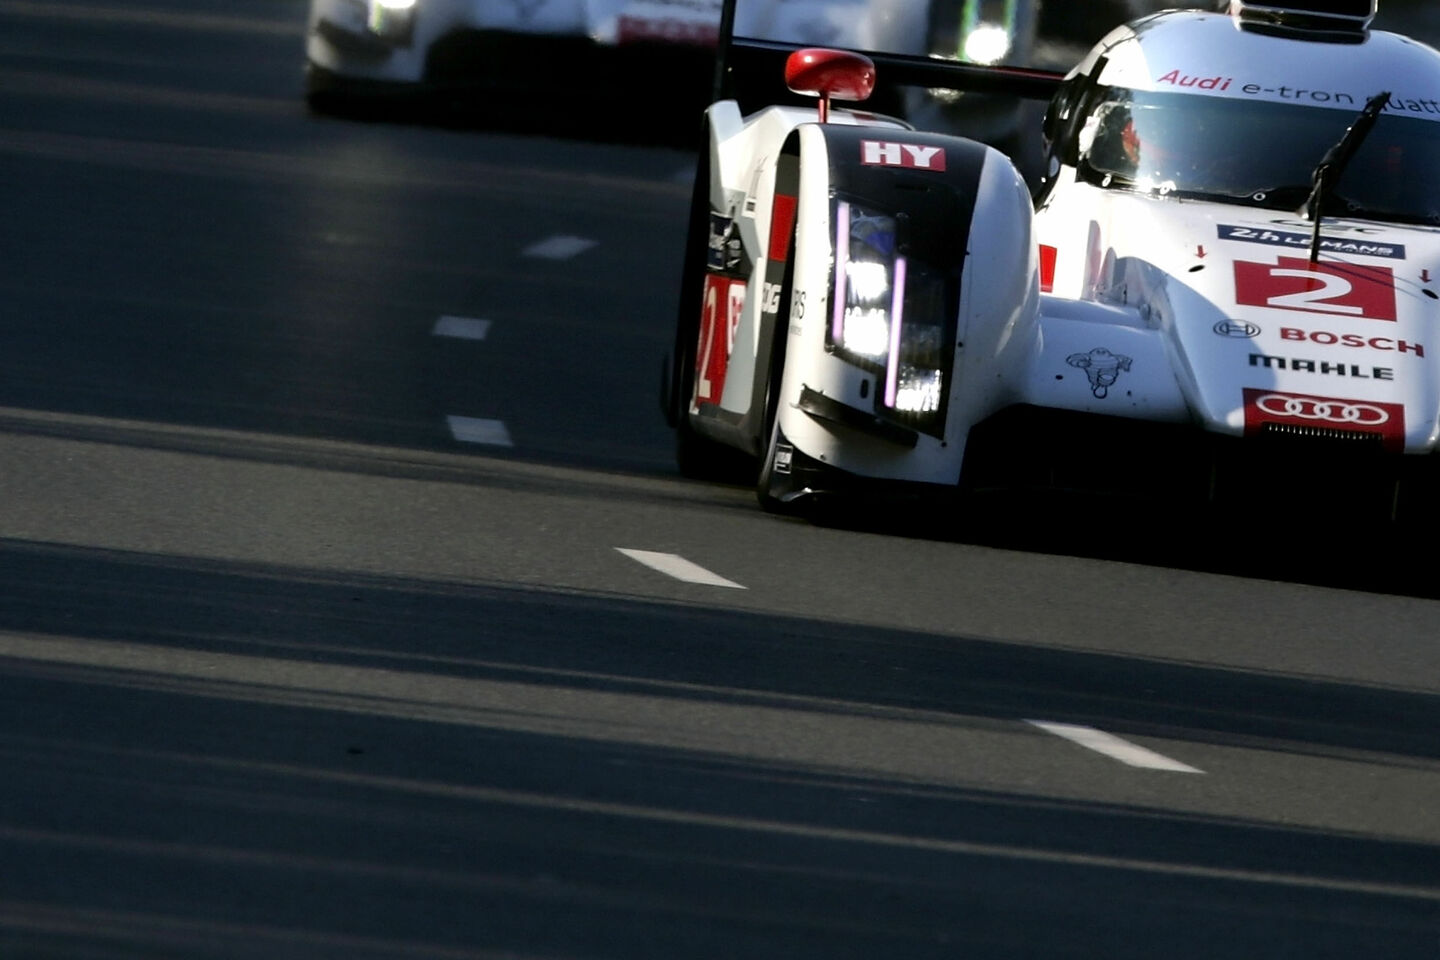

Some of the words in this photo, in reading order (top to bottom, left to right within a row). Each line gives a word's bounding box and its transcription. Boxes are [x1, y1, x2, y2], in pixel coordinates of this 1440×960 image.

[1157, 68, 1233, 91] Audi
[1241, 82, 1353, 105] e-tron
[863, 140, 941, 168] HY
[1320, 241, 1394, 257] MANS
[1266, 268, 1364, 315] 2
[1279, 326, 1425, 359] BOSCH
[1248, 352, 1395, 381] MAHLE
